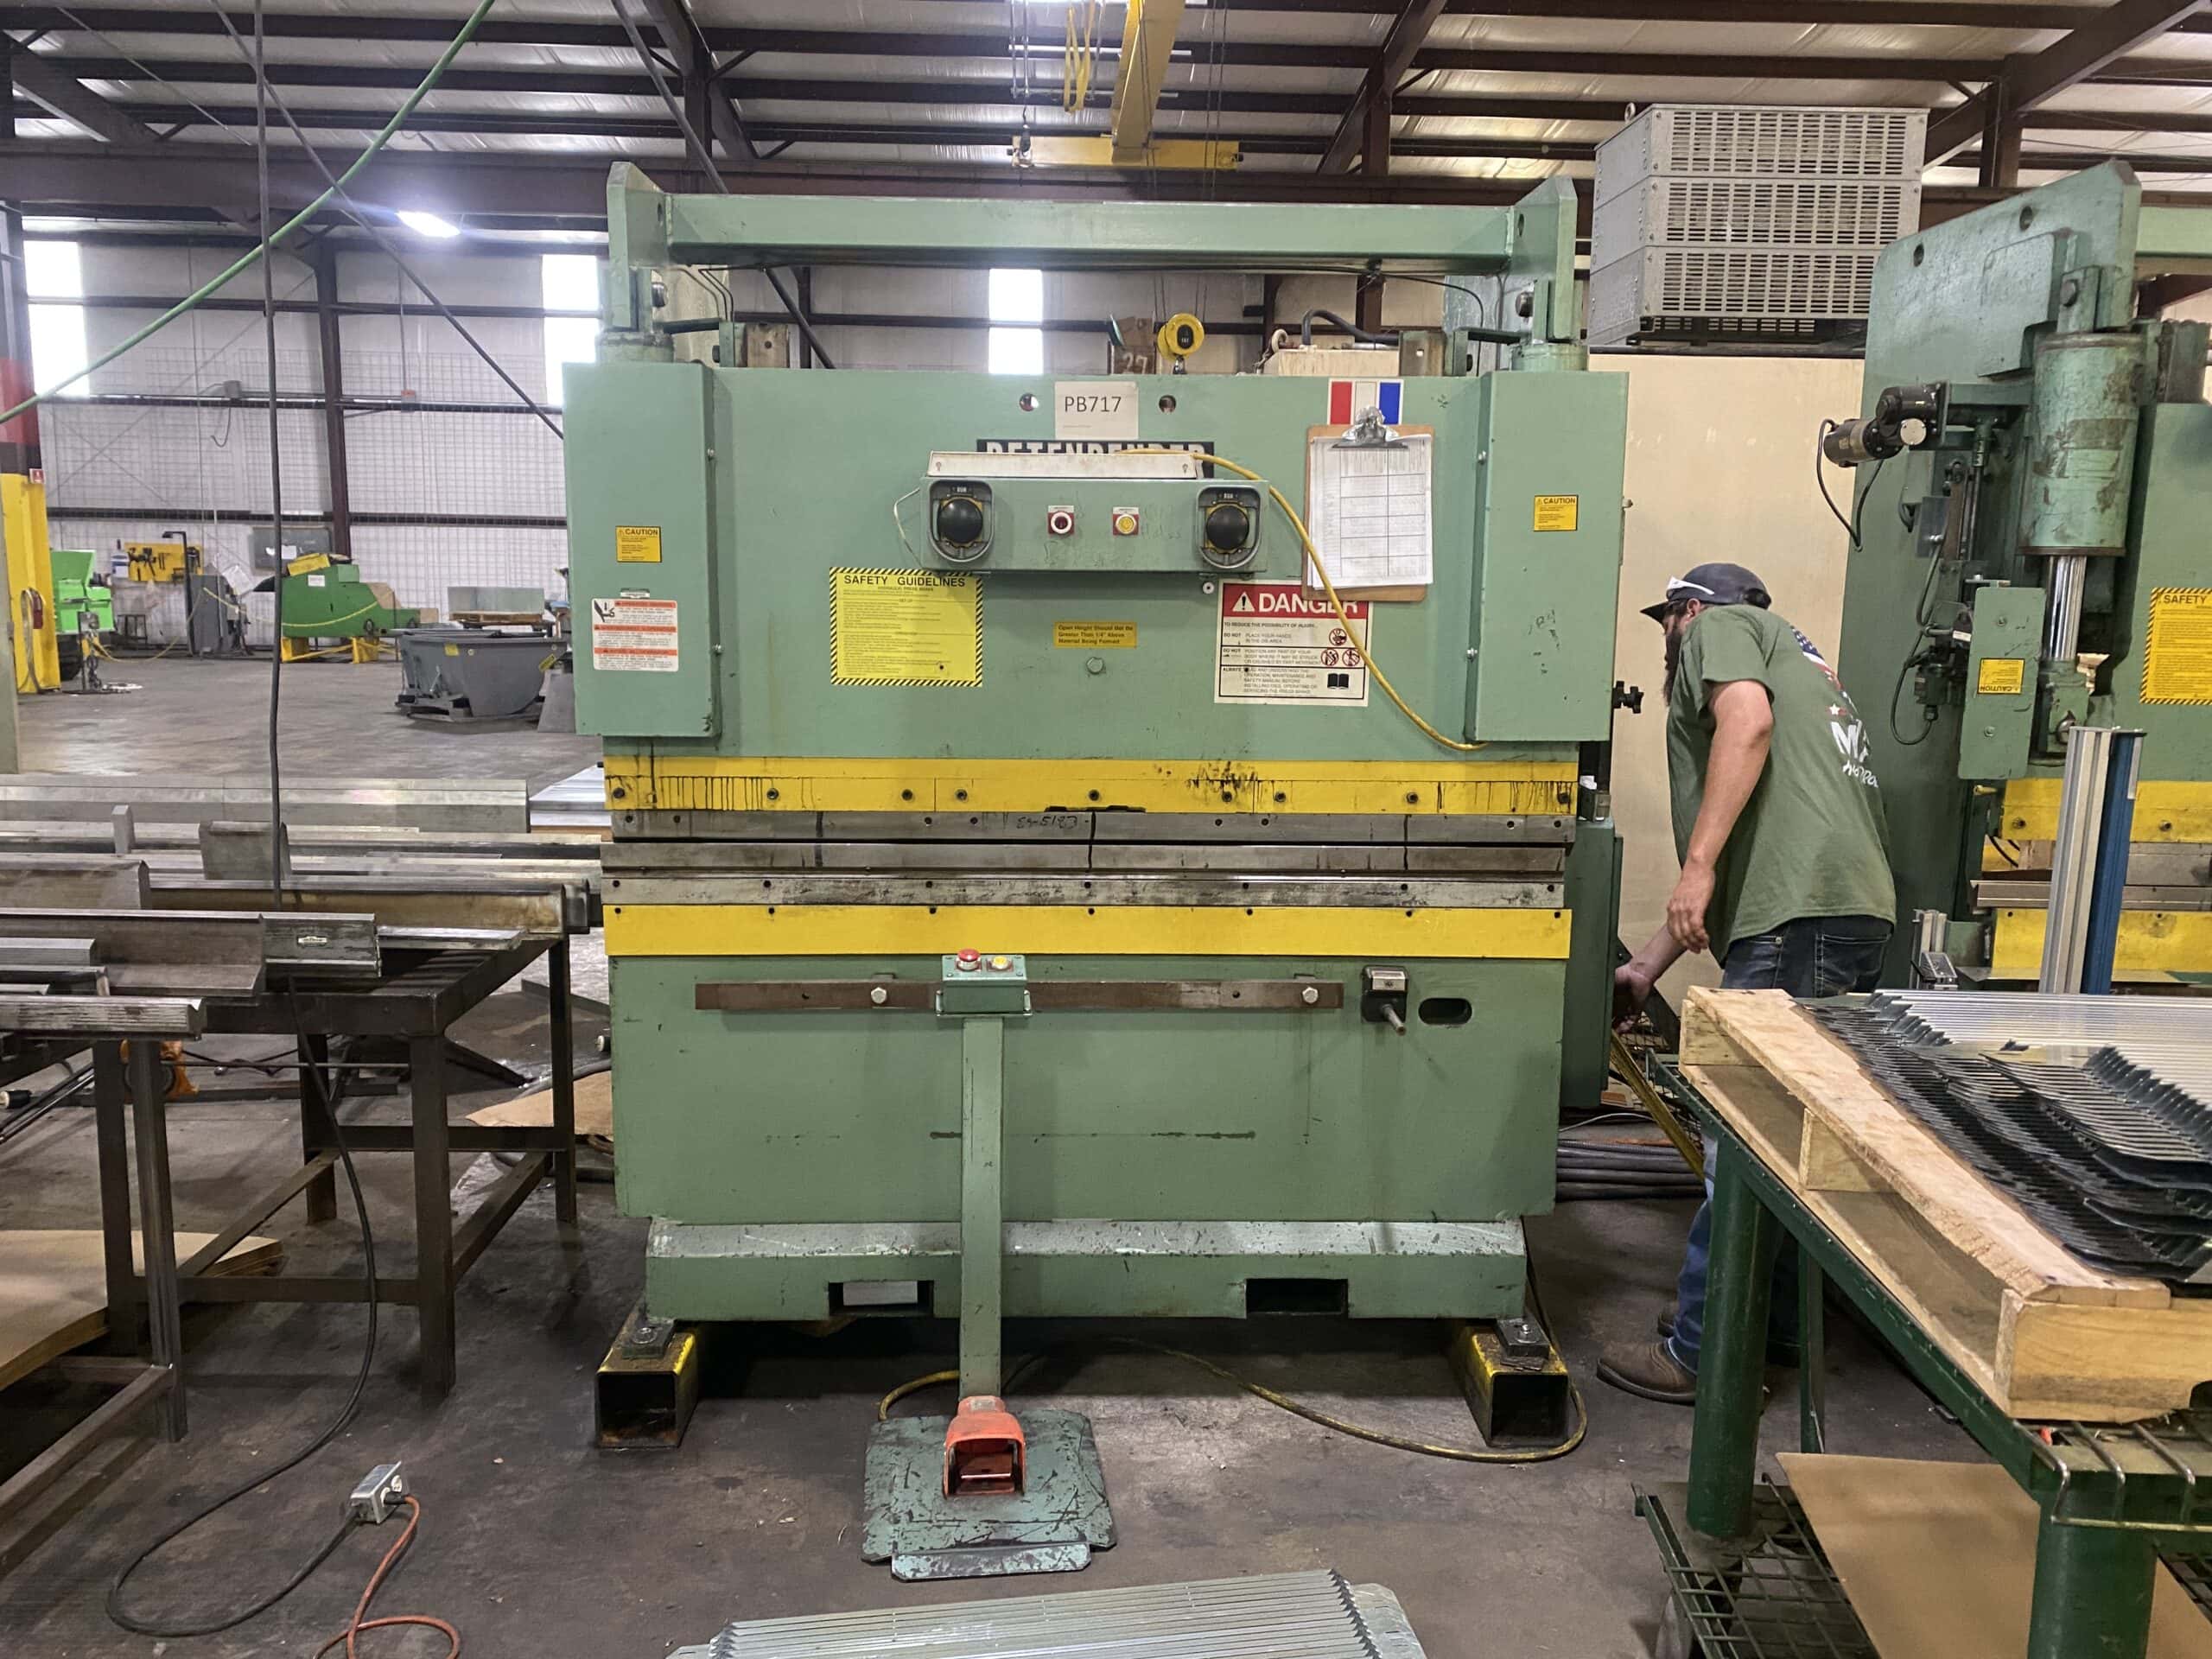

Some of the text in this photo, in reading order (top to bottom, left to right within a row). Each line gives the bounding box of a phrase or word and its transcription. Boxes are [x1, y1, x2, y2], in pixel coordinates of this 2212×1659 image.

[1065, 396, 1122, 412] PB717
[843, 575, 965, 587] SAFETY GUIDELINES
[2163, 594, 2208, 604] SAFETY
